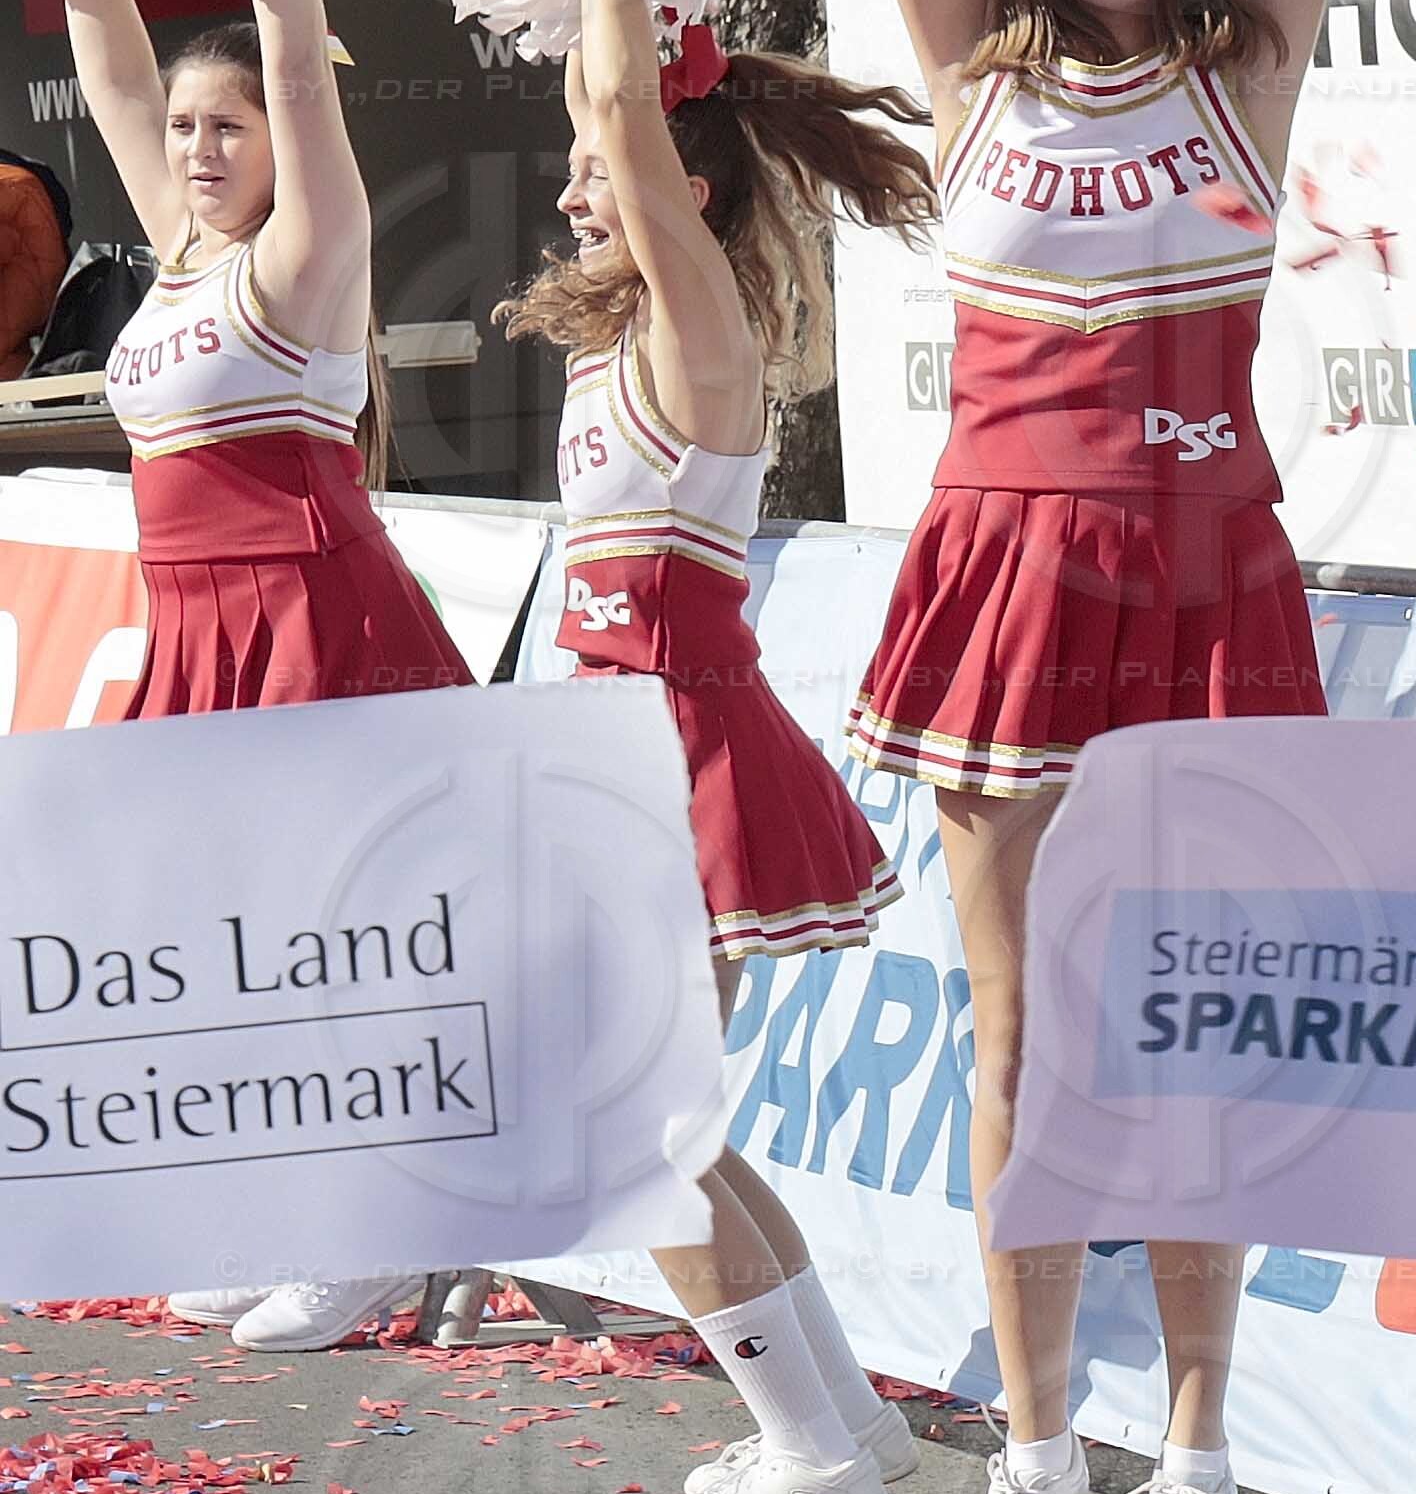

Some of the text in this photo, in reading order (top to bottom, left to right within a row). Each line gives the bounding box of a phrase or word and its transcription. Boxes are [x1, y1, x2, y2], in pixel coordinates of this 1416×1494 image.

[978, 136, 1221, 217] REDHOTS
[1143, 407, 1238, 462] DSG
[567, 577, 632, 633] DSG
[12, 893, 458, 1018] Das Land
[2, 1036, 479, 1155] Steiermark
